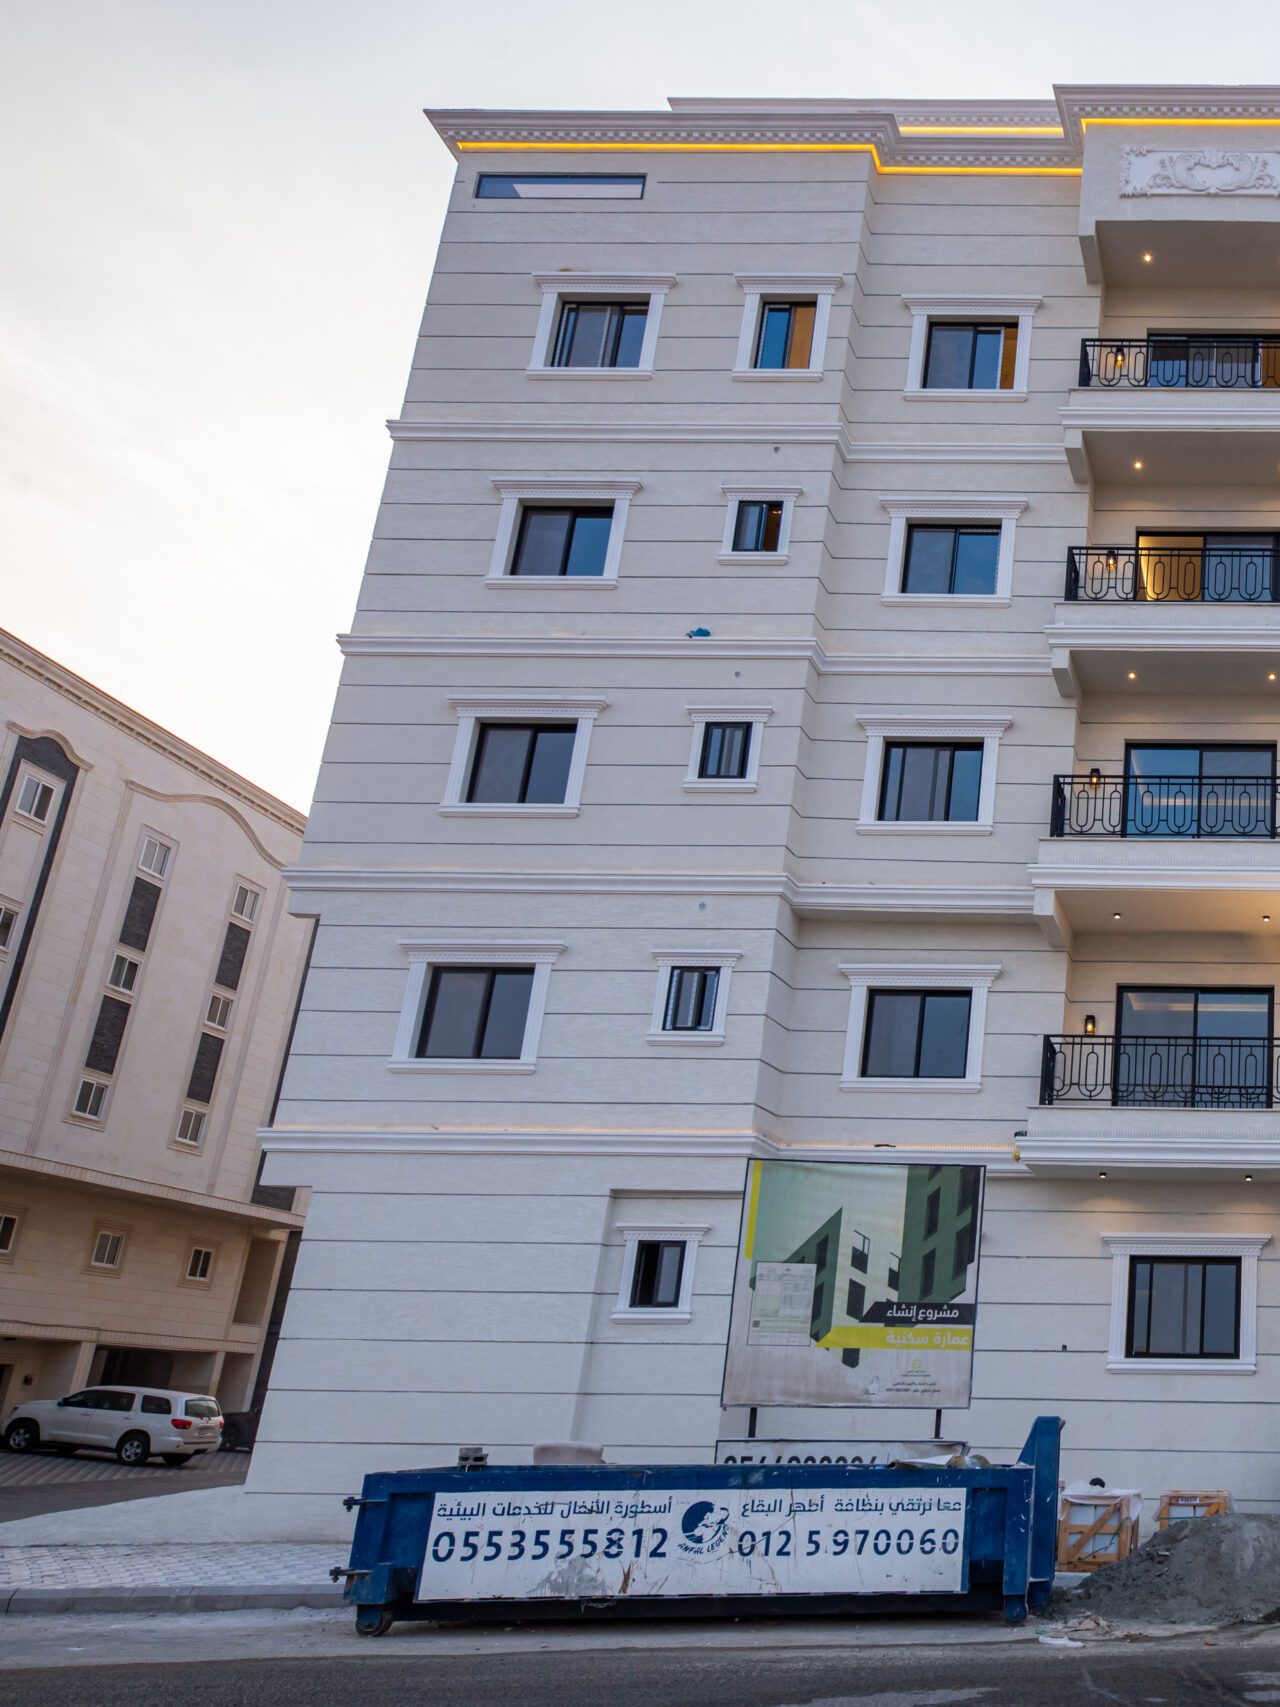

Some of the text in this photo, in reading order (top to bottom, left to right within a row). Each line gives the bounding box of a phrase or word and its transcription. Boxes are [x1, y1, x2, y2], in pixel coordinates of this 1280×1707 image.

[886, 1304, 959, 1322] مشروع إنشاء
[886, 1330, 970, 1348] عمارة سكنية
[436, 1495, 673, 1521] أسطورة الأنفال للخدمات البيئية
[740, 1494, 962, 1518] معا نرتقي بنظافة أطهر البقاع
[431, 1527, 668, 1563] 0553555812
